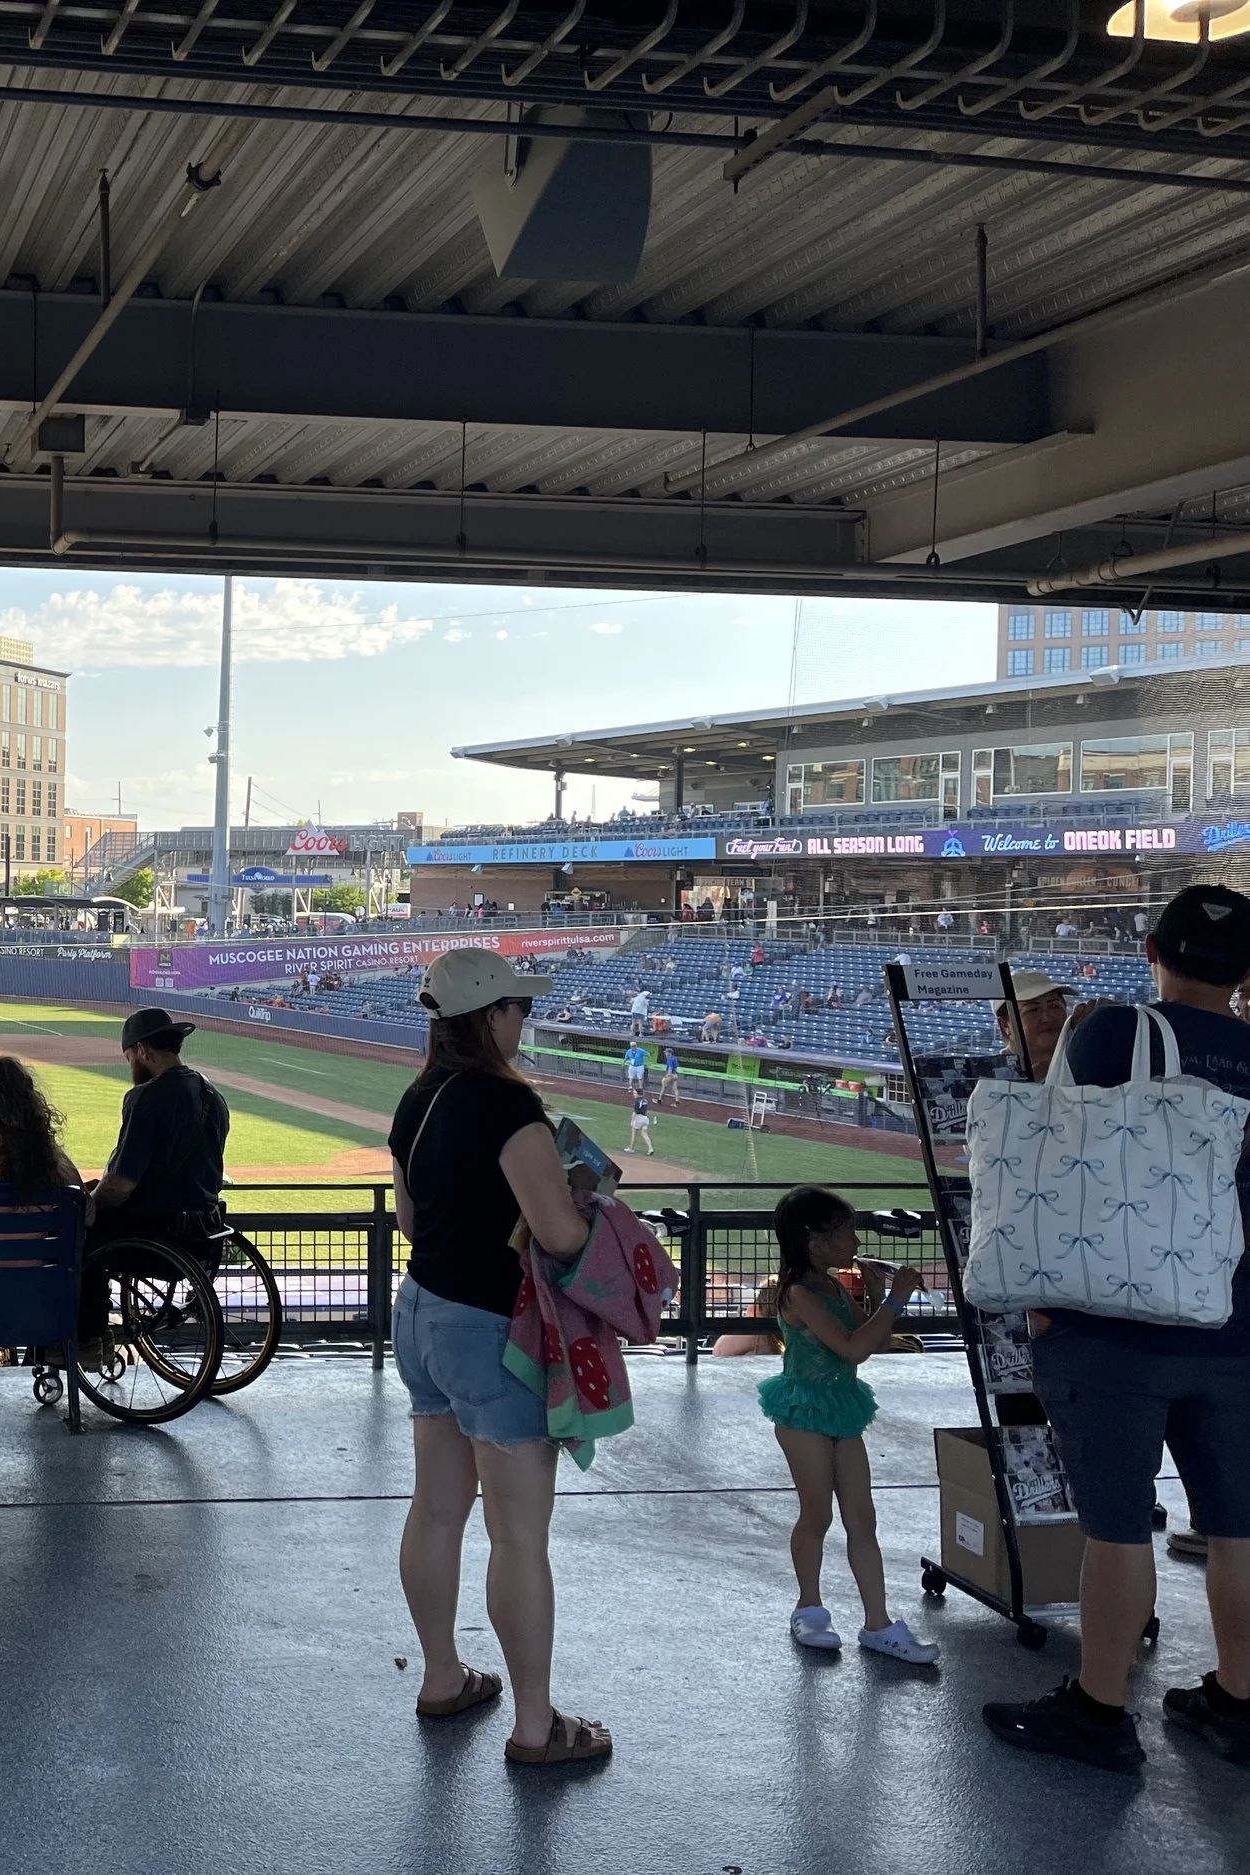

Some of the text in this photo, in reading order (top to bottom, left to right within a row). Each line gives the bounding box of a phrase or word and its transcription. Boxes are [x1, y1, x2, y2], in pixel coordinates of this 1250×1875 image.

[37, 677, 61, 691] mazars
[291, 828, 405, 852] Coors LIGHT
[807, 834, 924, 855] ALL SEASON LONG
[981, 828, 1176, 852] Welcome to ONEOK FIELD
[452, 851, 472, 861] LIGHT
[492, 845, 599, 860] REFINERY DECK
[634, 842, 689, 858] Coors LIGHT
[521, 933, 615, 948] riverspirittulsa.com
[18, 947, 45, 957] RESORT
[56, 946, 113, 961] Party Platform
[208, 936, 501, 966] MUSCOGEE NATION GAMING ENTERPRISES
[284, 955, 419, 975] RIVER SPIRIT CASINO RESORT
[914, 968, 993, 980] Free Gameday
[917, 984, 970, 997] Magazine
[248, 1005, 271, 1024] QuikTrip
[1012, 1477, 1063, 1502] Drillers
